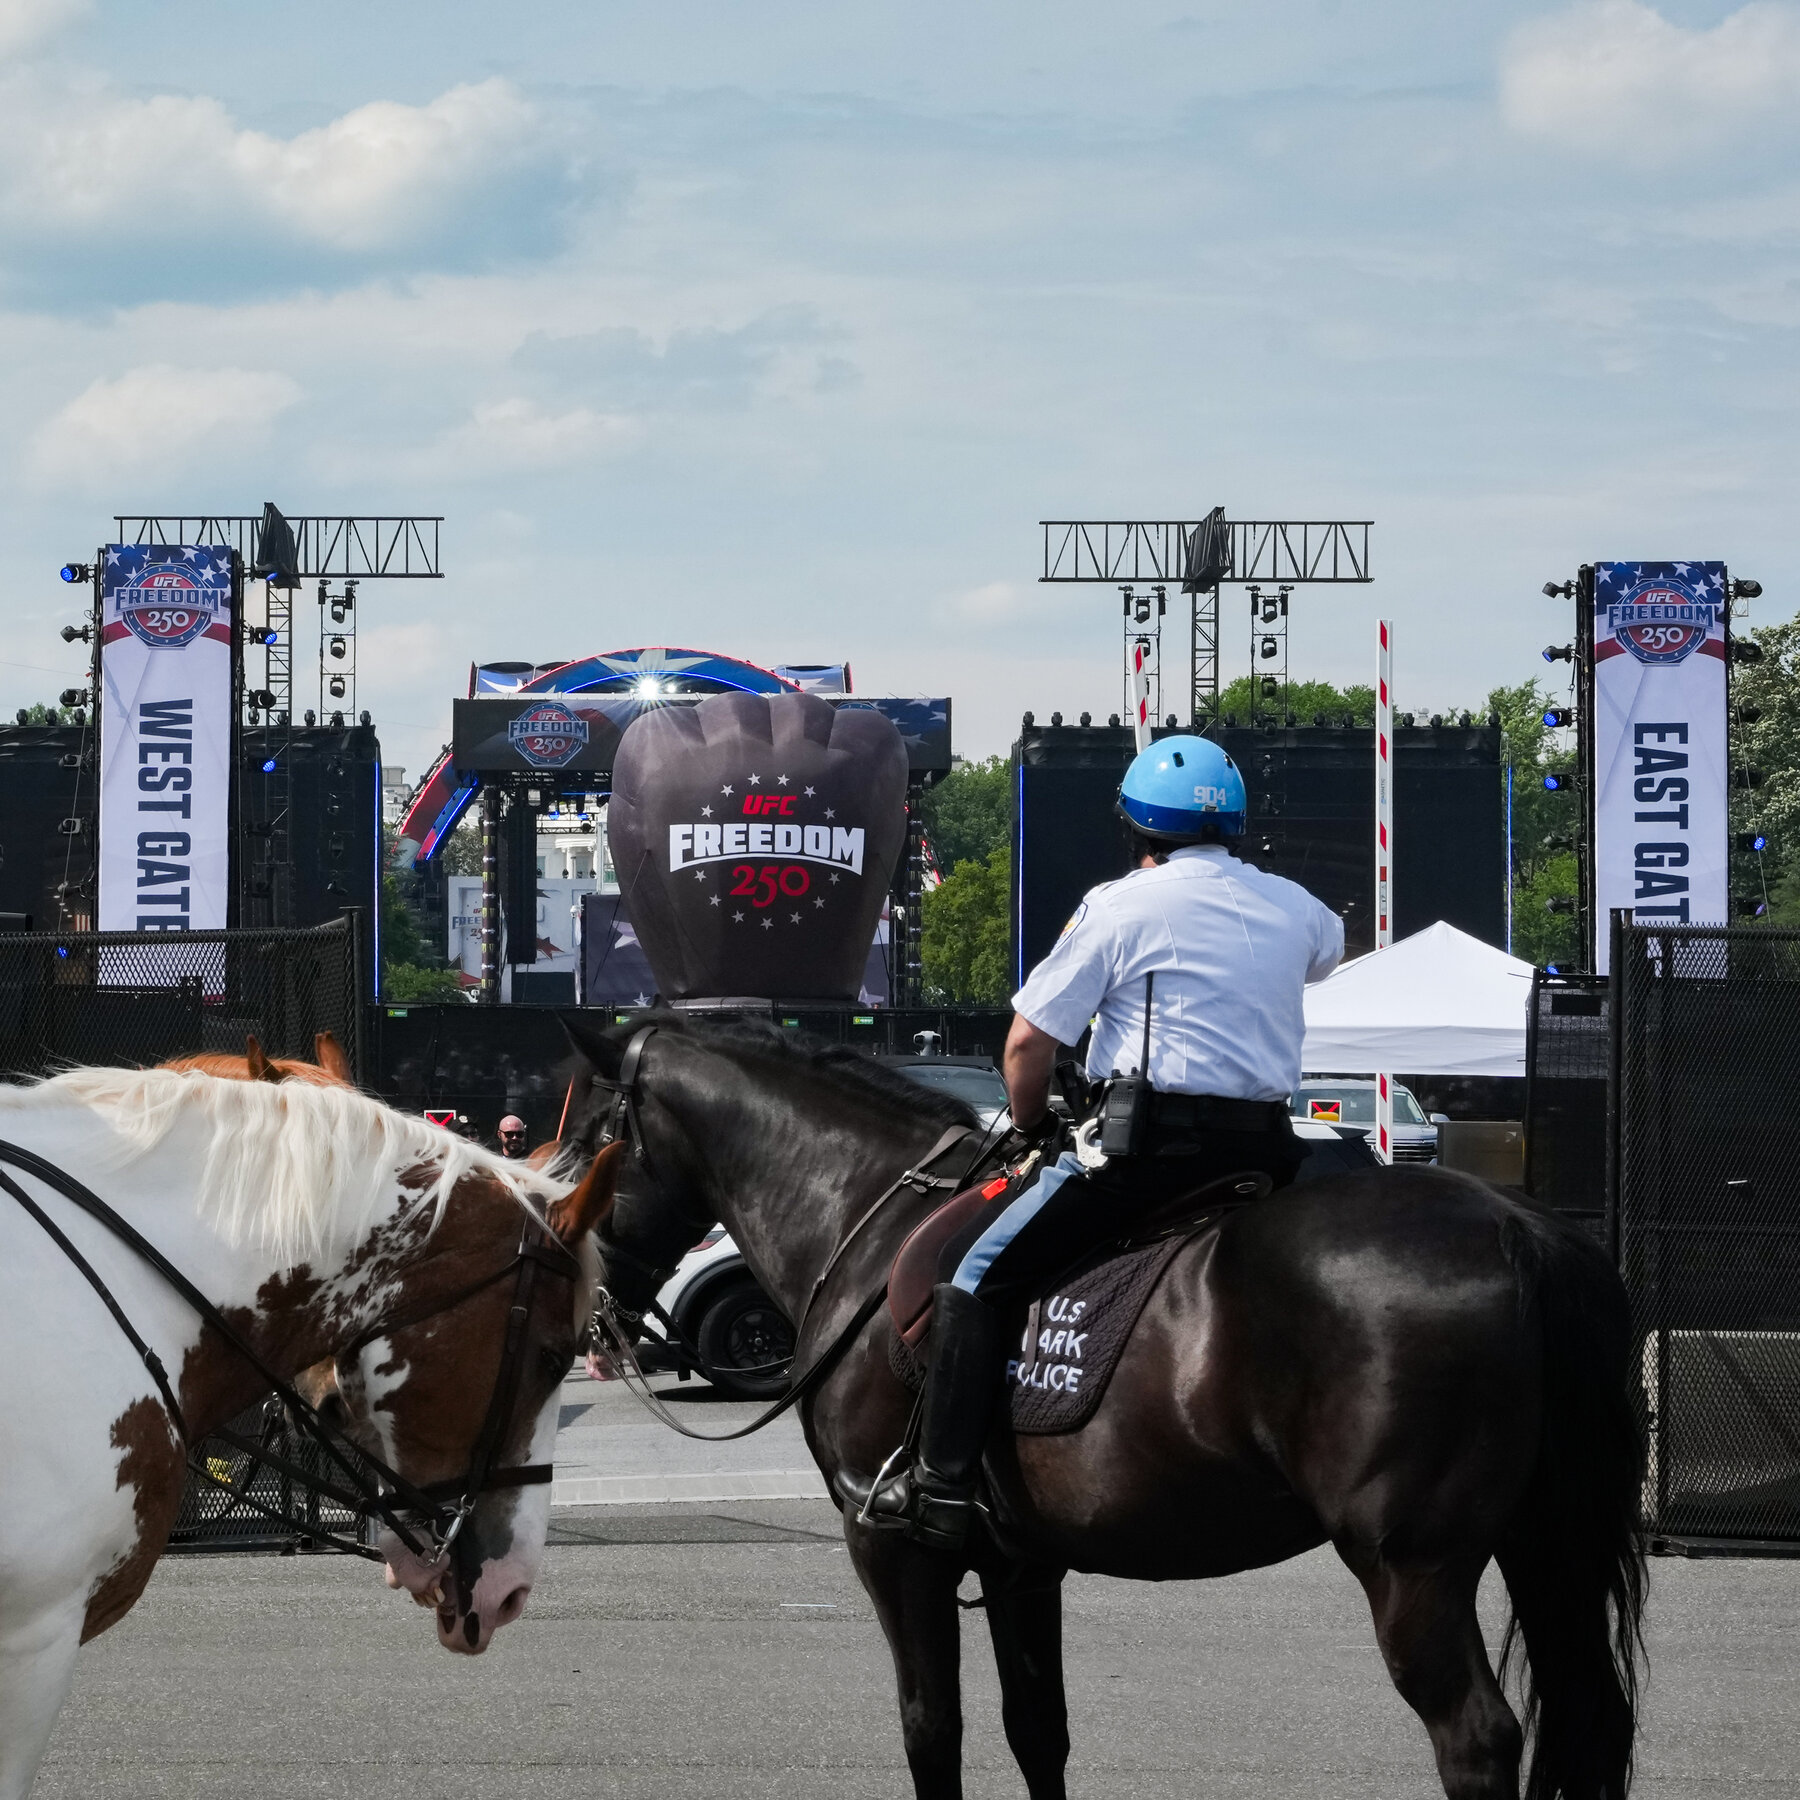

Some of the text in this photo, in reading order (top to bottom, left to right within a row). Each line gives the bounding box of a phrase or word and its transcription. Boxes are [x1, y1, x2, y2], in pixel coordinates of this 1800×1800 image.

[153, 576, 182, 587] UFC
[115, 588, 219, 612] FREEDOM
[1646, 592, 1675, 603] UFC
[146, 611, 189, 633] 250
[1608, 605, 1714, 628] FREEDOM
[1640, 627, 1684, 649] 250
[538, 712, 560, 720] UFC
[510, 722, 588, 740] FREEDOM
[533, 737, 566, 754] 250
[138, 698, 193, 819] WEST
[742, 795, 798, 815] UFC
[1193, 785, 1227, 806] 904
[1634, 722, 1689, 924] EAST GAT
[669, 823, 865, 876] FREEDOM
[729, 865, 811, 908] 250
[452, 916, 482, 929] FREE
[470, 928, 482, 940] 25
[1007, 1360, 1084, 1393] POLICE
